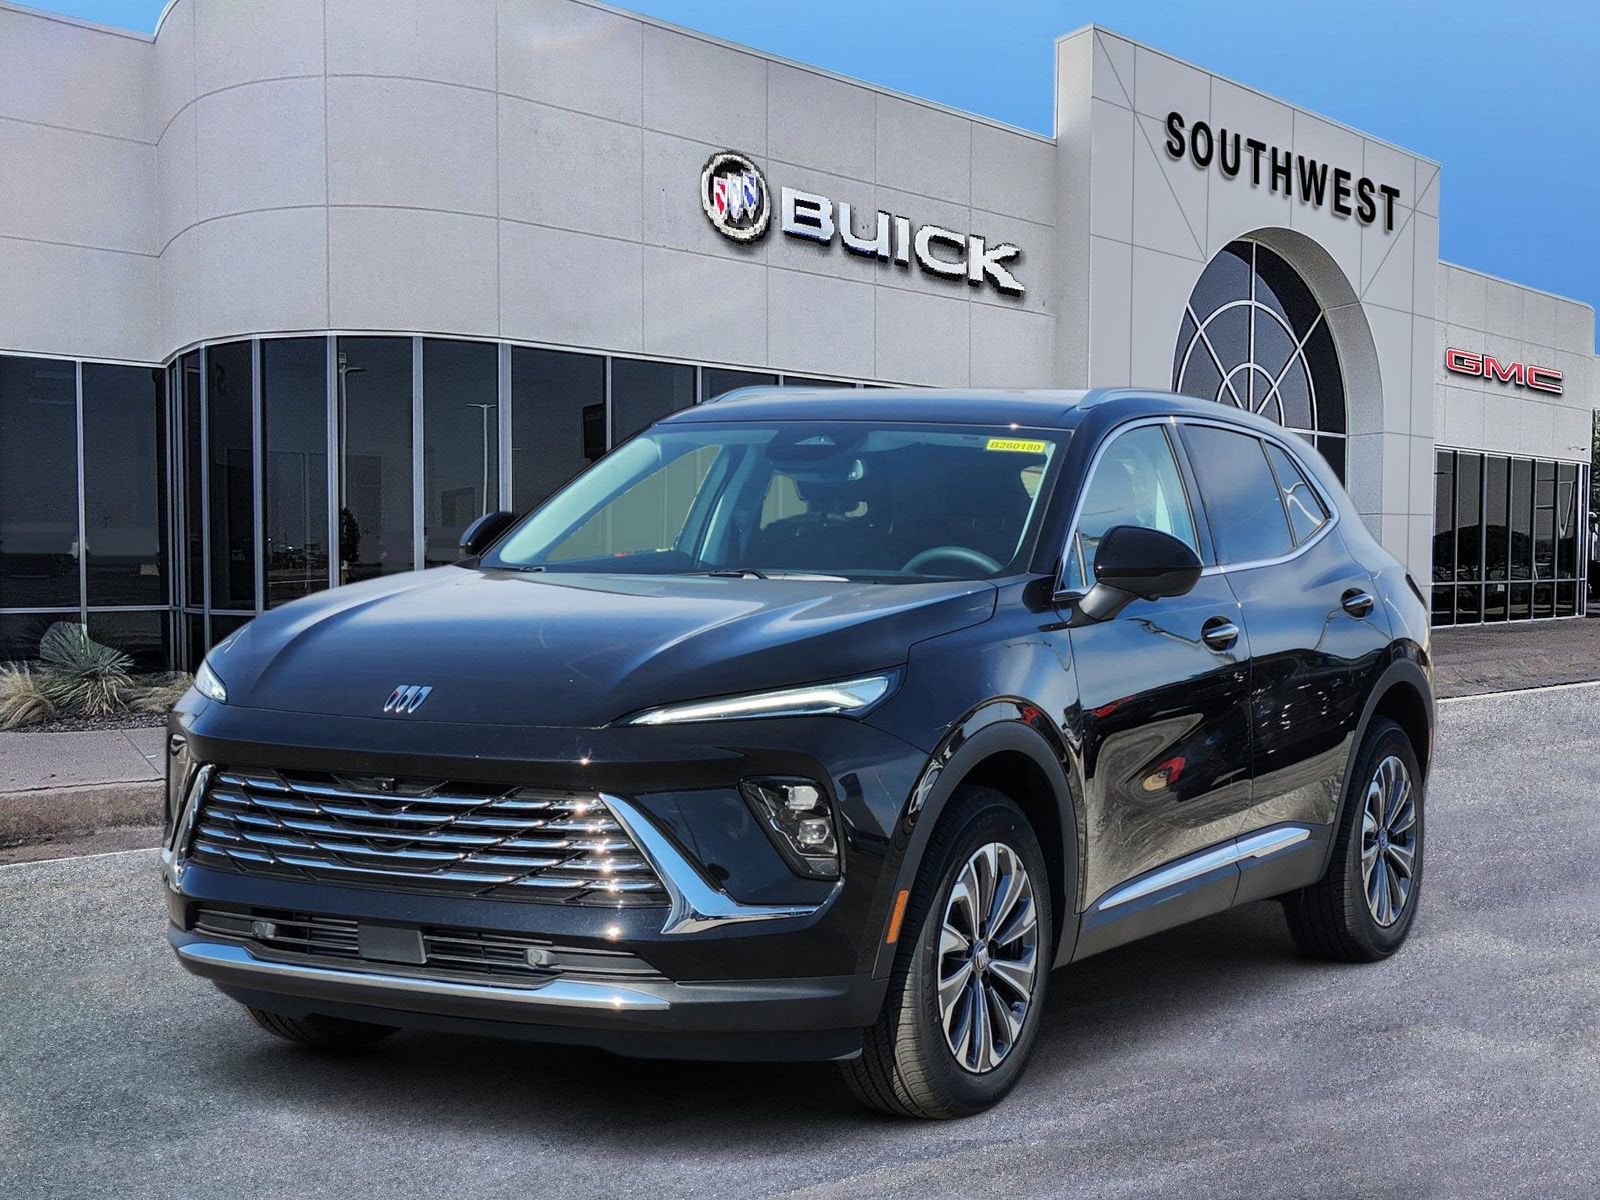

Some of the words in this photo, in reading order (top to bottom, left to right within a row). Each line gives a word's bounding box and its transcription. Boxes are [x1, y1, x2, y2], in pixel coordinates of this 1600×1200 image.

[1166, 112, 1400, 231] SOUTHWEST
[781, 186, 1026, 296] BUICK
[1446, 347, 1563, 394] GMC
[990, 441, 1042, 451] B260180
